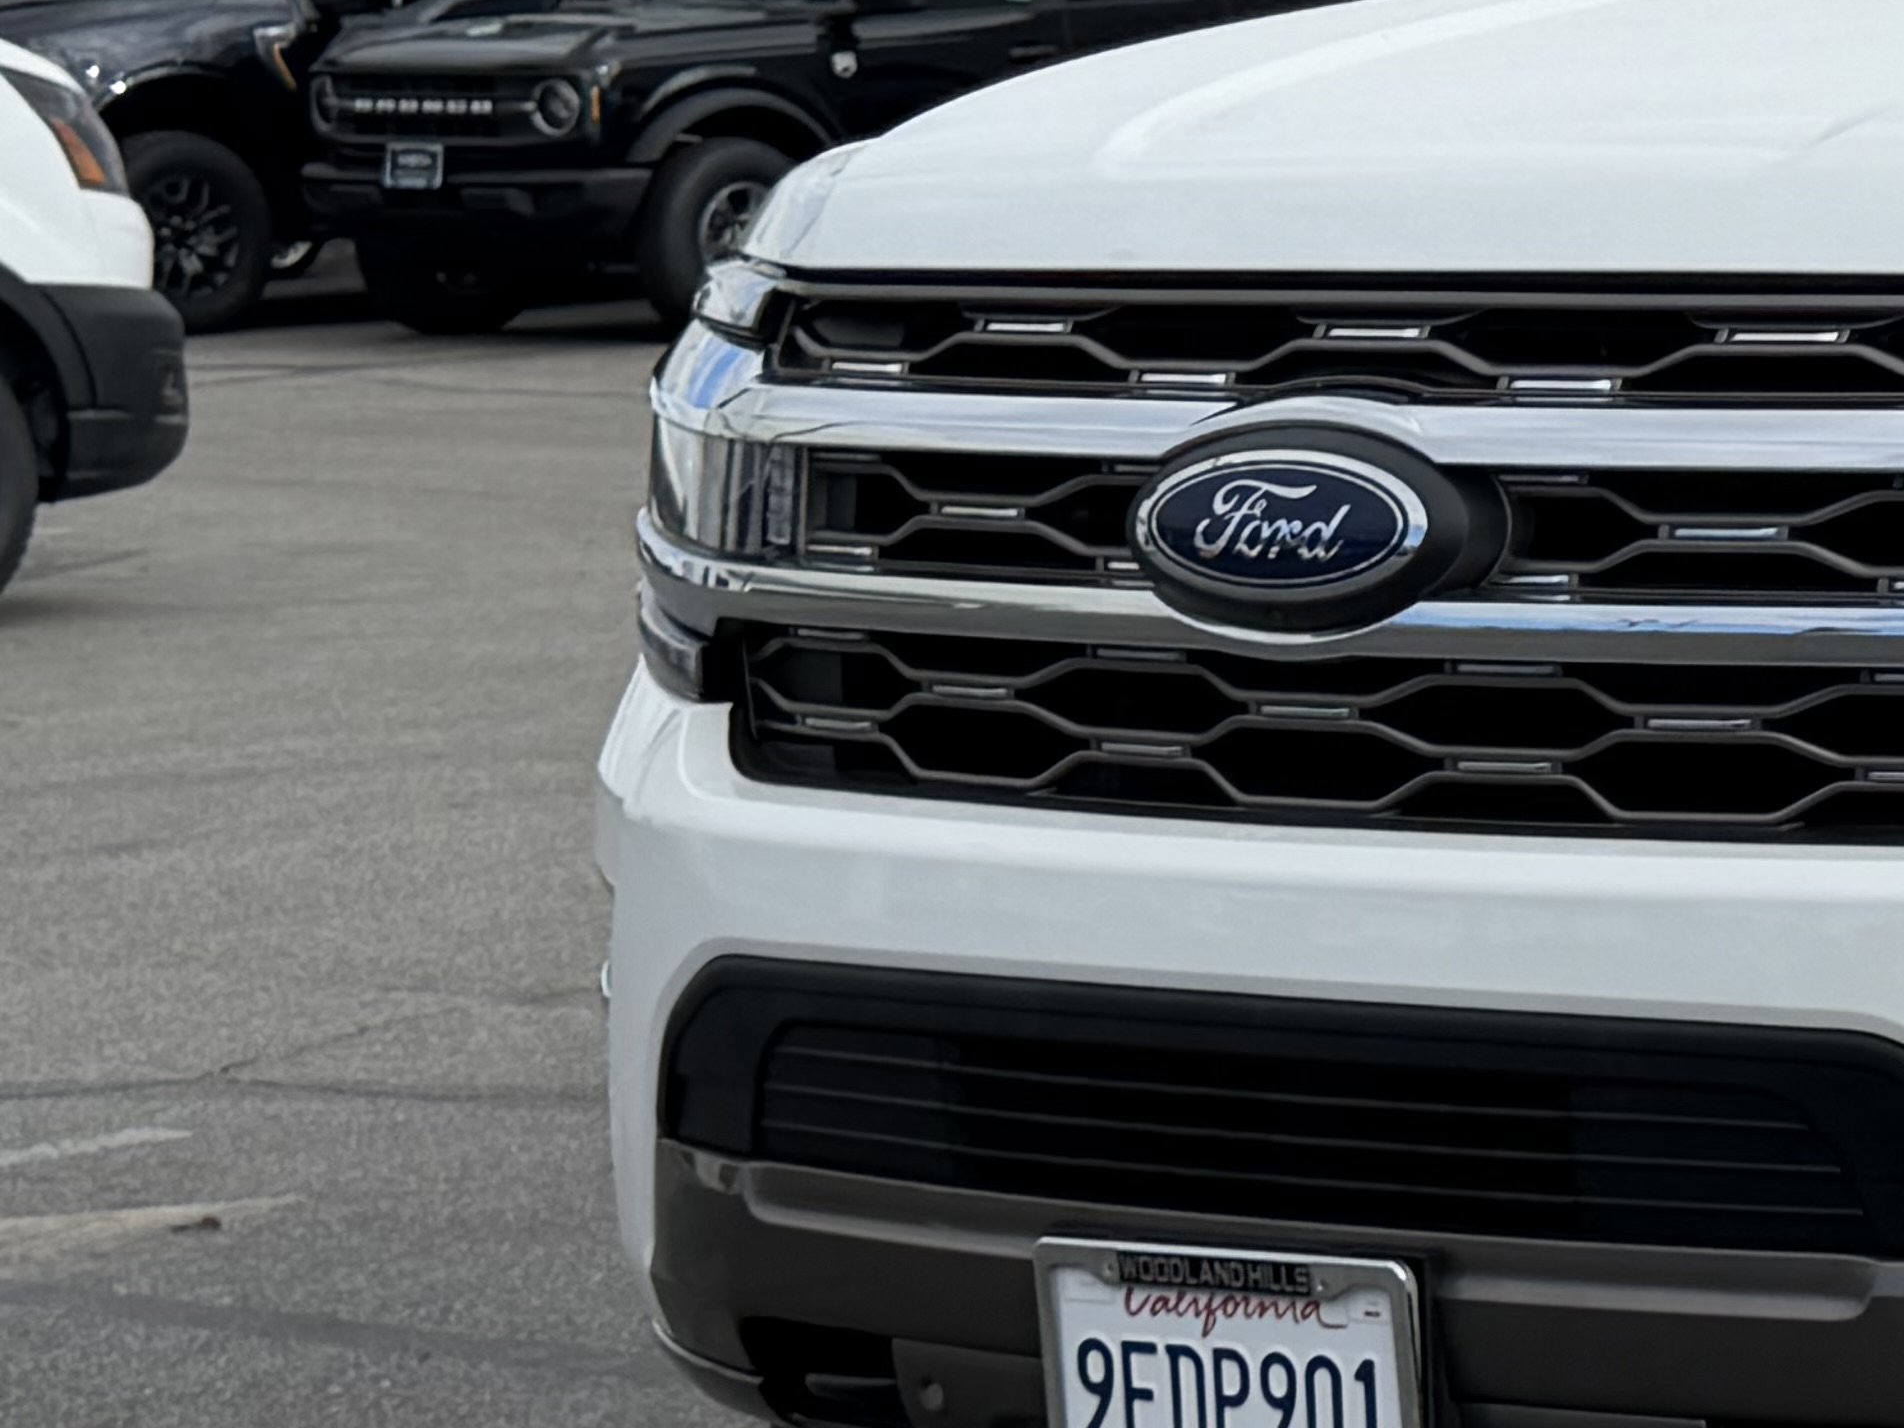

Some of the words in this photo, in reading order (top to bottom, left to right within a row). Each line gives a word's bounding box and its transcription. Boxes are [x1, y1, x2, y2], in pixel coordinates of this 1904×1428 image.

[1194, 478, 1351, 562] Ford
[1120, 1254, 1245, 1288] WOODLAND
[1249, 1262, 1311, 1293] HILLS
